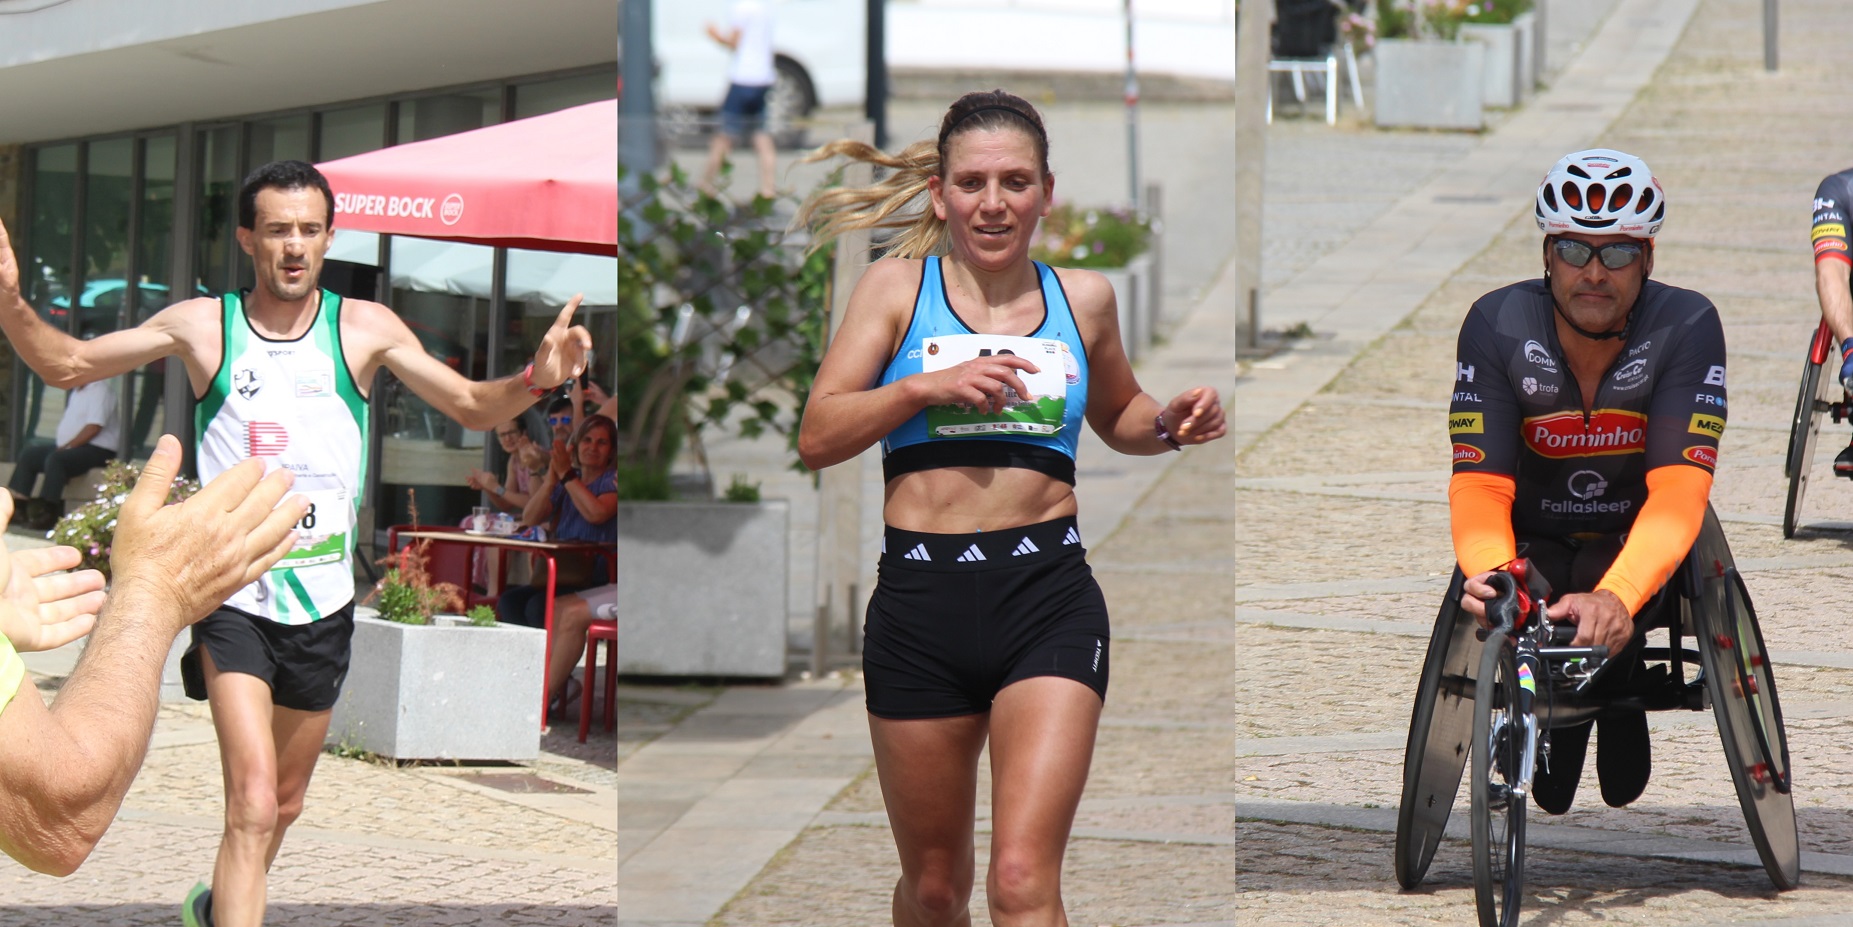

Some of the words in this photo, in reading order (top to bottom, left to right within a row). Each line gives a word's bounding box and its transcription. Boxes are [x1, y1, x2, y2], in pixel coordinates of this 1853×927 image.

[334, 192, 385, 216] SUPER
[387, 196, 435, 219] BOCK
[1456, 362, 1475, 382] H
[1703, 365, 1726, 389] B
[1539, 383, 1559, 394] trofa
[1534, 426, 1643, 448] Porminho
[1541, 499, 1631, 514] Fallasleep
